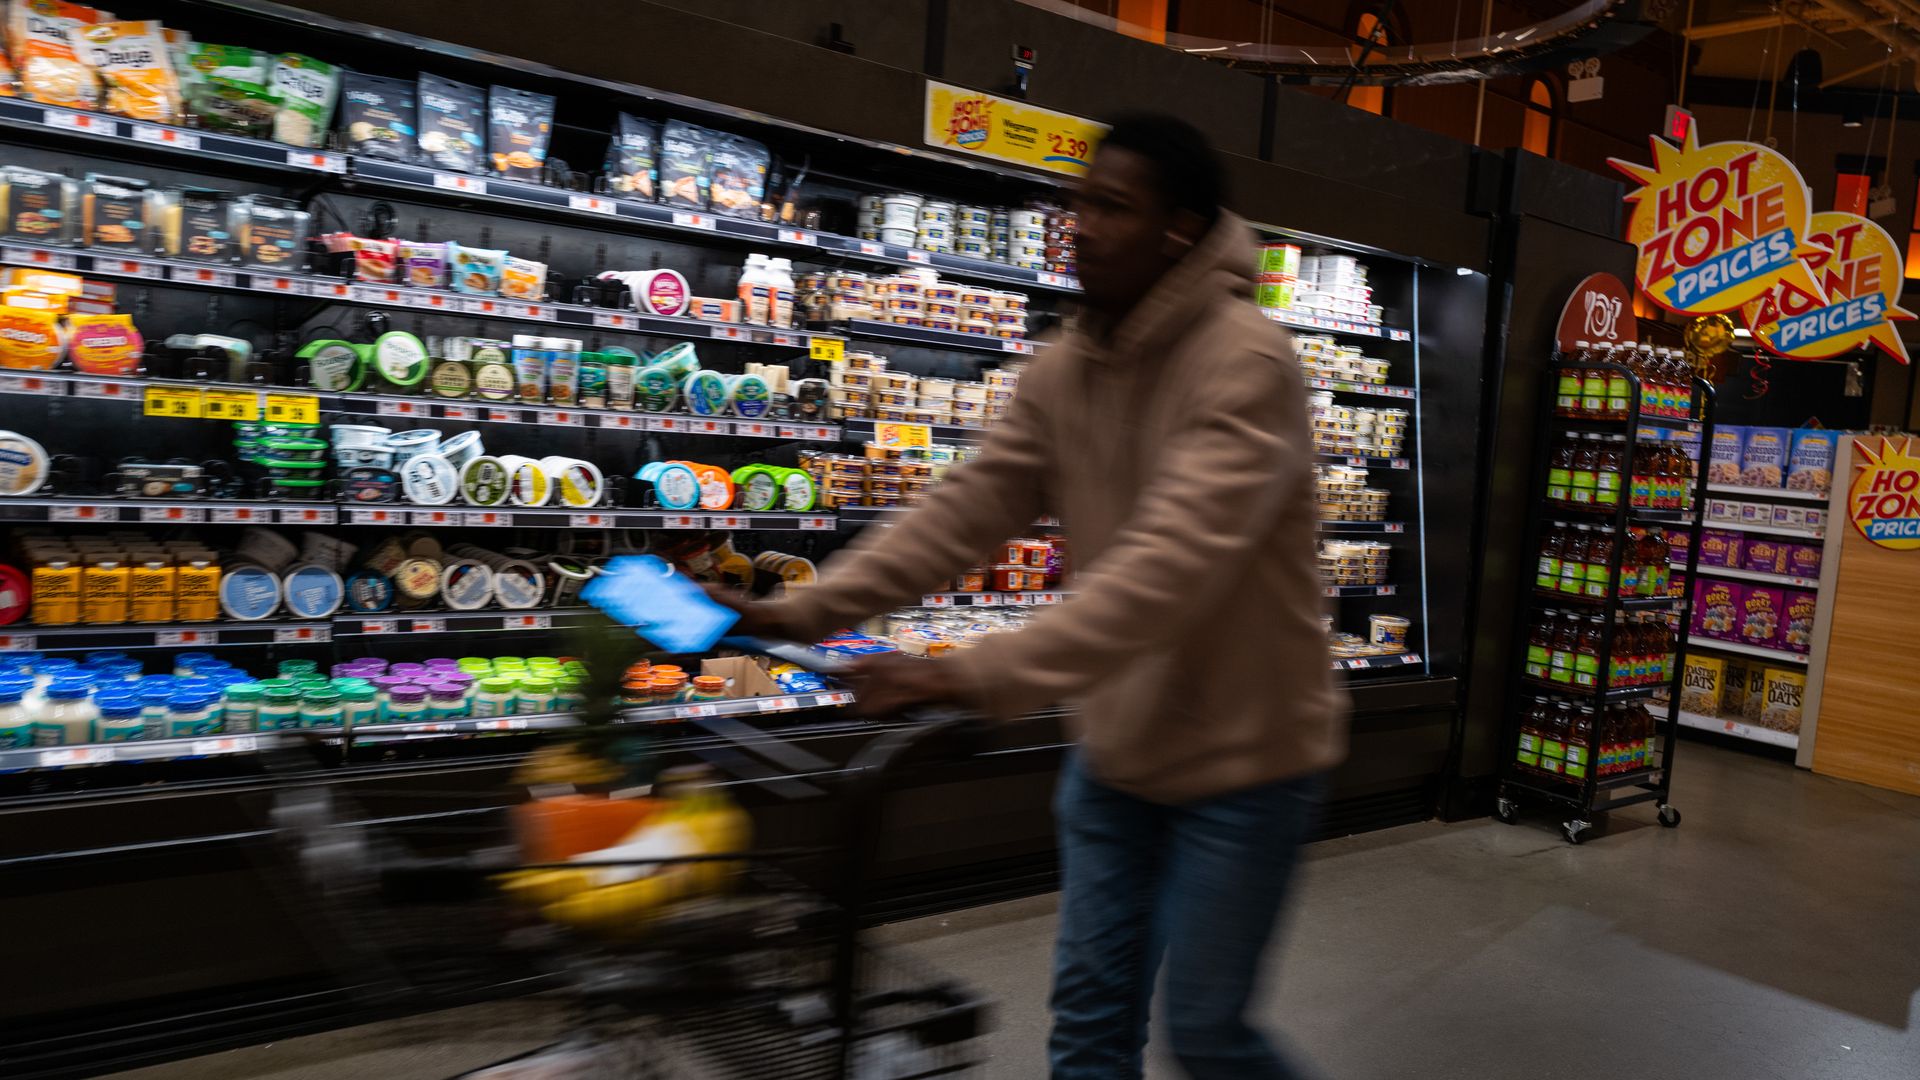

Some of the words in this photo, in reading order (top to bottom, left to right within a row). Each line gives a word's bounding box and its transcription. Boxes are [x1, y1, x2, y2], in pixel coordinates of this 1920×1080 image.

[953, 99, 984, 116] HOT
[949, 114, 989, 135] ZONE
[1003, 131, 1037, 145] Hummus
[1047, 132, 1088, 158] $2.39
[1657, 151, 1758, 232] HOT
[1642, 184, 1786, 290] ZONE
[1801, 223, 1863, 270] OT
[1677, 231, 1790, 304] PRICES
[1780, 294, 1882, 347] PRICES
[1871, 469, 1920, 493] HO
[1856, 493, 1920, 520] ZON
[1871, 520, 1920, 537] PRIC
[1685, 673, 1715, 690] OATS
[1768, 689, 1802, 707] OATS
